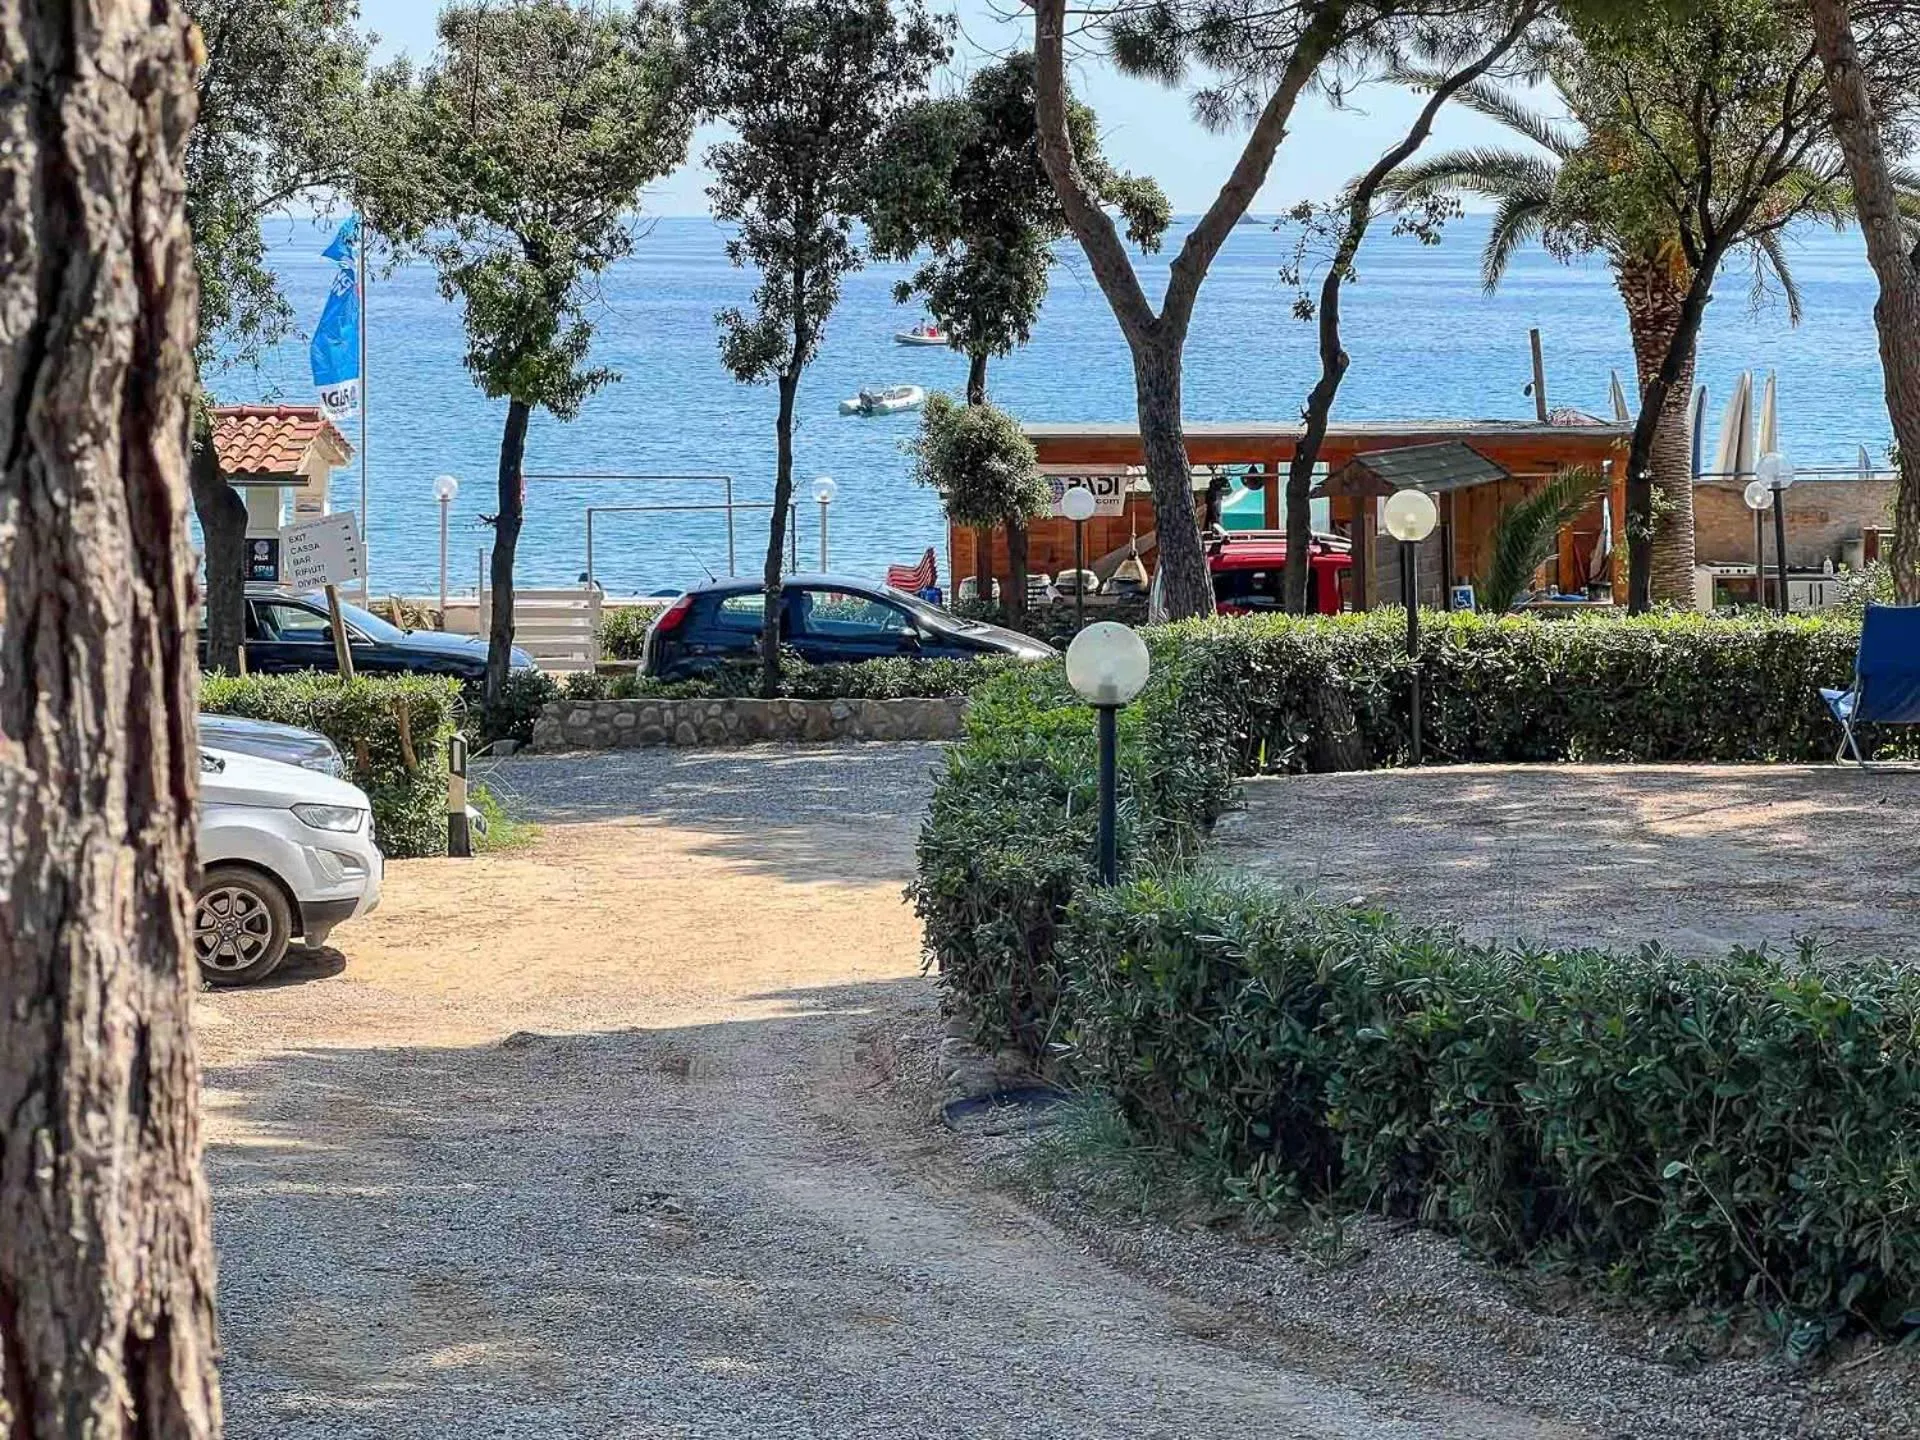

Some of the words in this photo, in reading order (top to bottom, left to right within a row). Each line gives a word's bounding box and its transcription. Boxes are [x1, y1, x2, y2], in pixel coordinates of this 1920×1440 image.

[1068, 477, 1119, 495] PADI
[288, 533, 306, 544] EXIT
[290, 543, 320, 555] CASSA
[293, 555, 312, 566] BAR
[295, 564, 325, 577] RIFIUTI
[297, 575, 328, 588] DIVING
